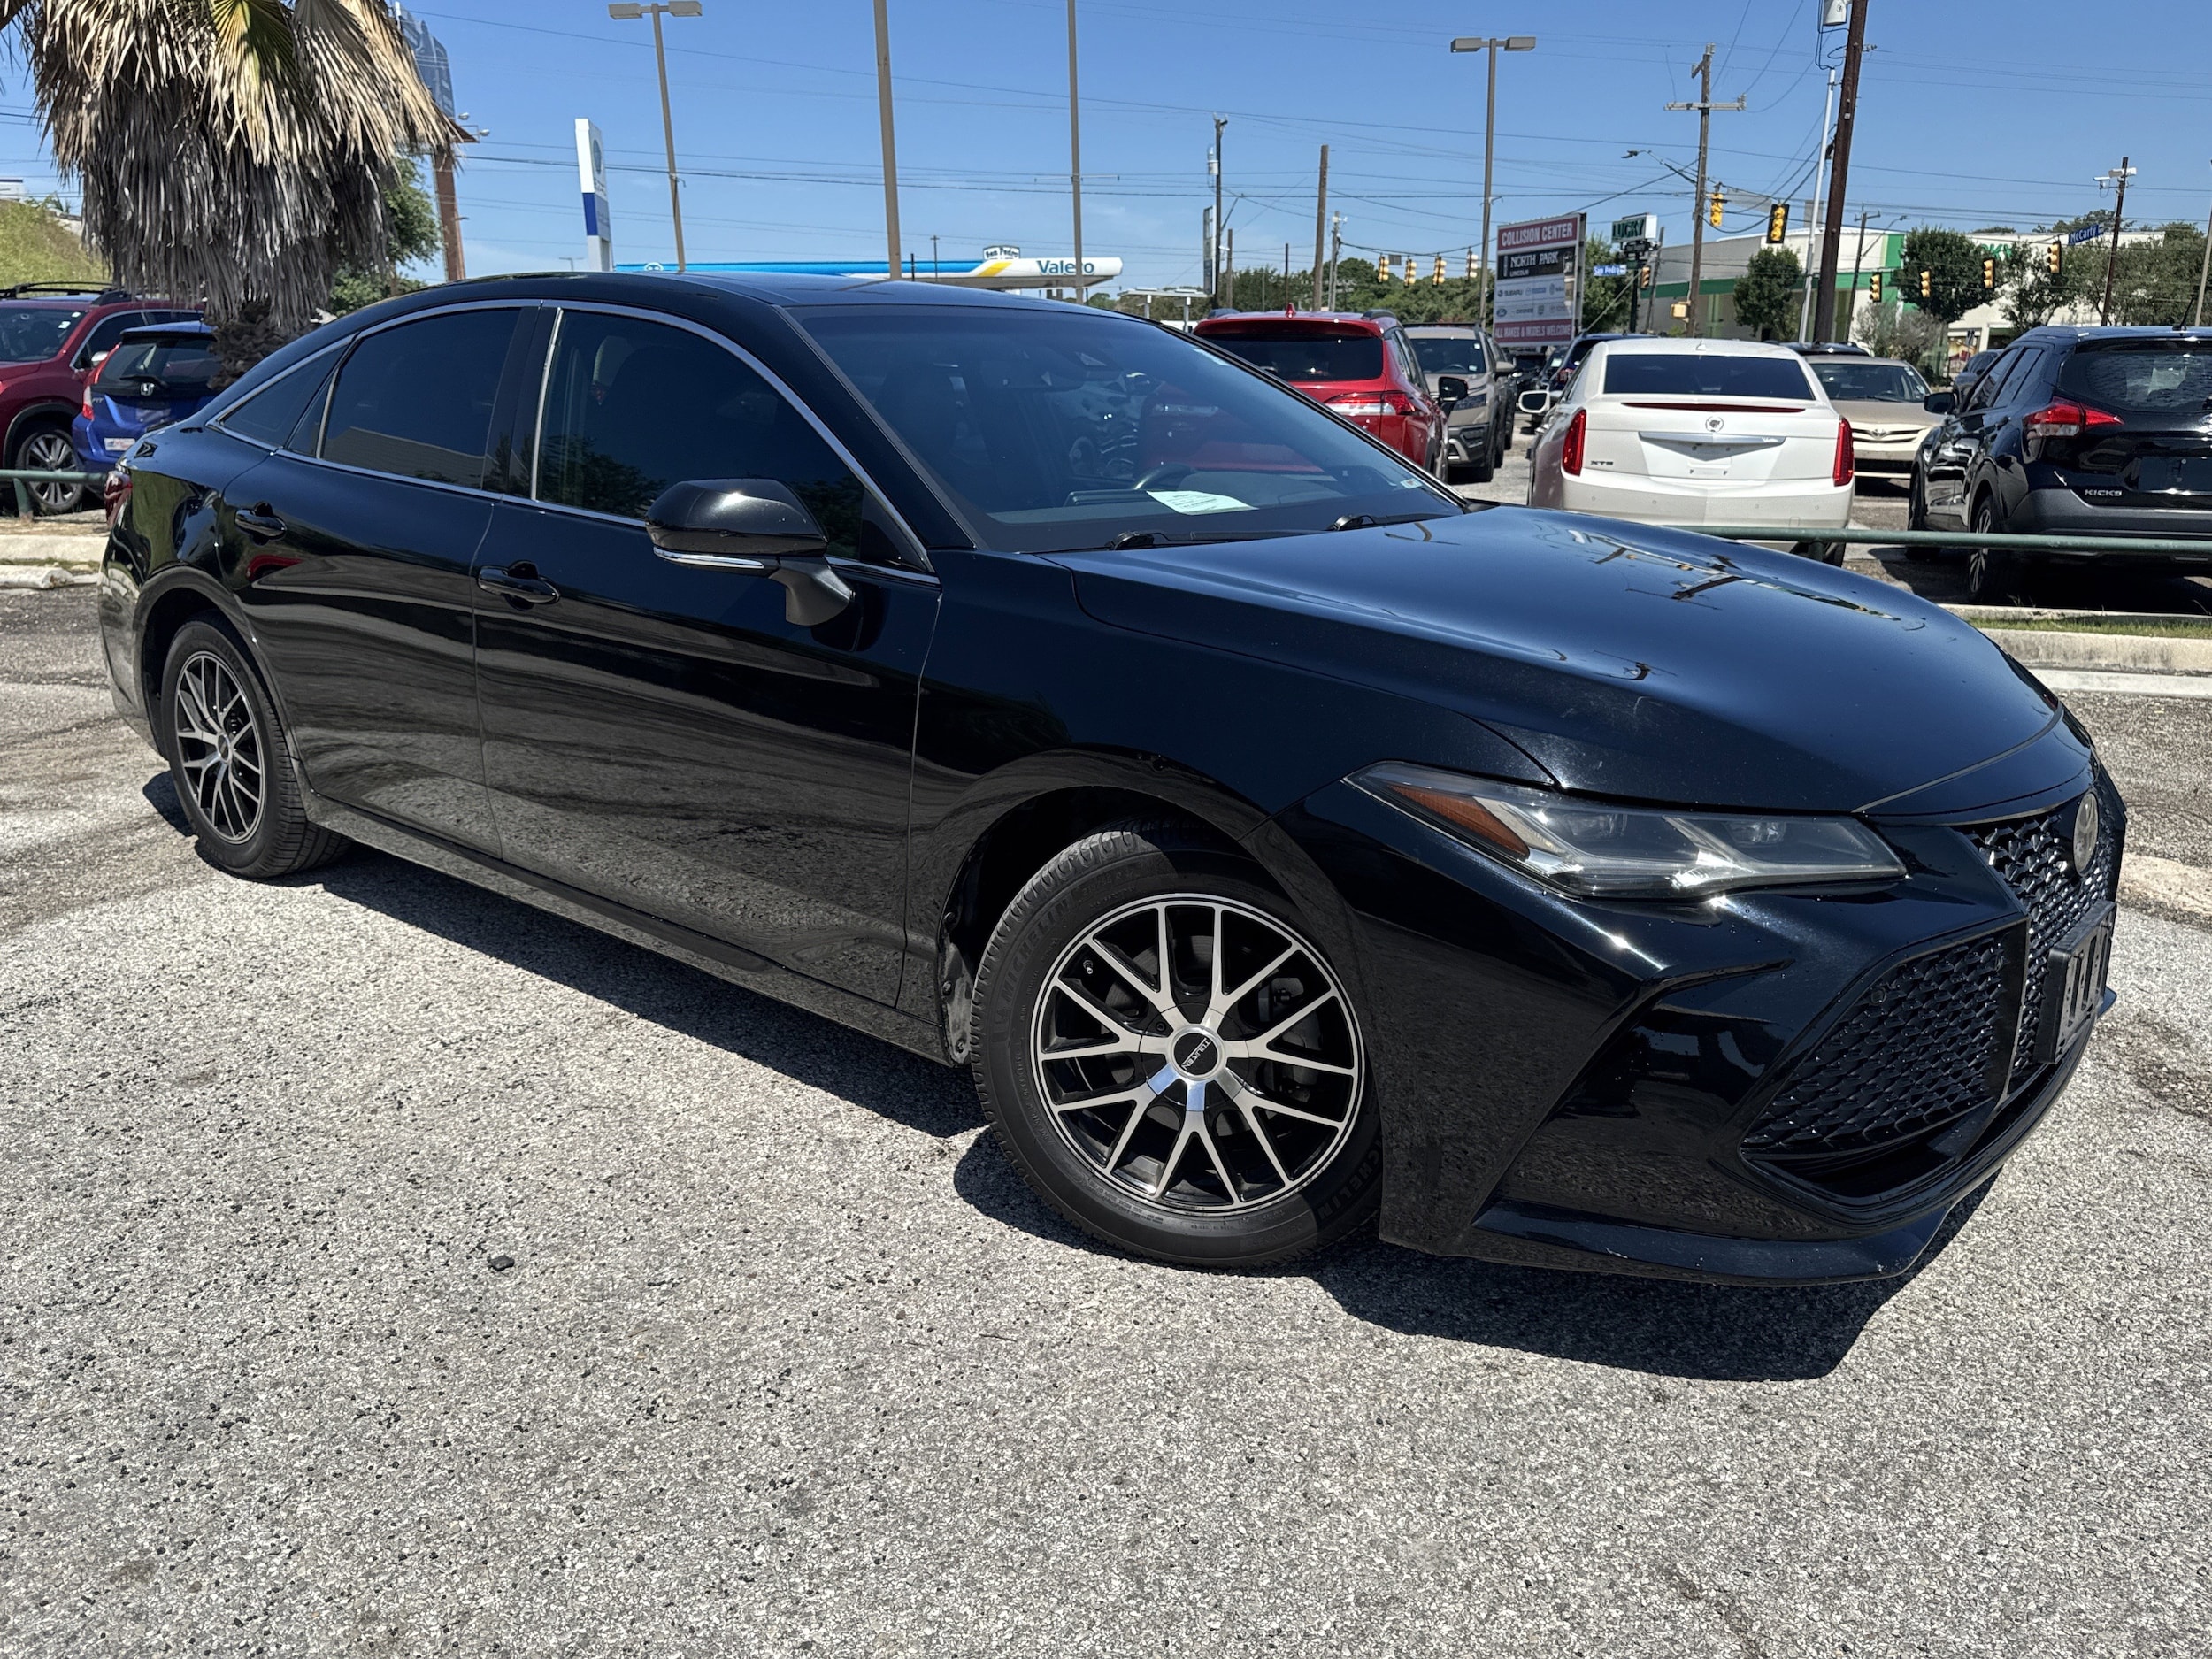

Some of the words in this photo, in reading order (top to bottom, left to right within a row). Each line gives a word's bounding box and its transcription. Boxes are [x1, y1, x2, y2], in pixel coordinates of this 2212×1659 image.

[1502, 227, 1540, 247] COLLISION
[1541, 222, 1573, 241] CENTER
[1612, 219, 1645, 238] LUCKY
[2070, 227, 2097, 243] McCarty
[1036, 260, 1094, 274] Valeo
[1510, 254, 1536, 268] NORTH
[1539, 251, 1558, 265] PARK
[1509, 268, 1530, 277] LINCOLN
[1494, 326, 1503, 339] ALL
[1504, 326, 1520, 338] MAKES
[1525, 325, 1546, 337] MODELS
[1546, 324, 1571, 336] WELCOME
[2084, 488, 2123, 497] KICKS
[1001, 895, 1074, 1003] MICHELIN
[1317, 1135, 1384, 1221] ICHELIN
